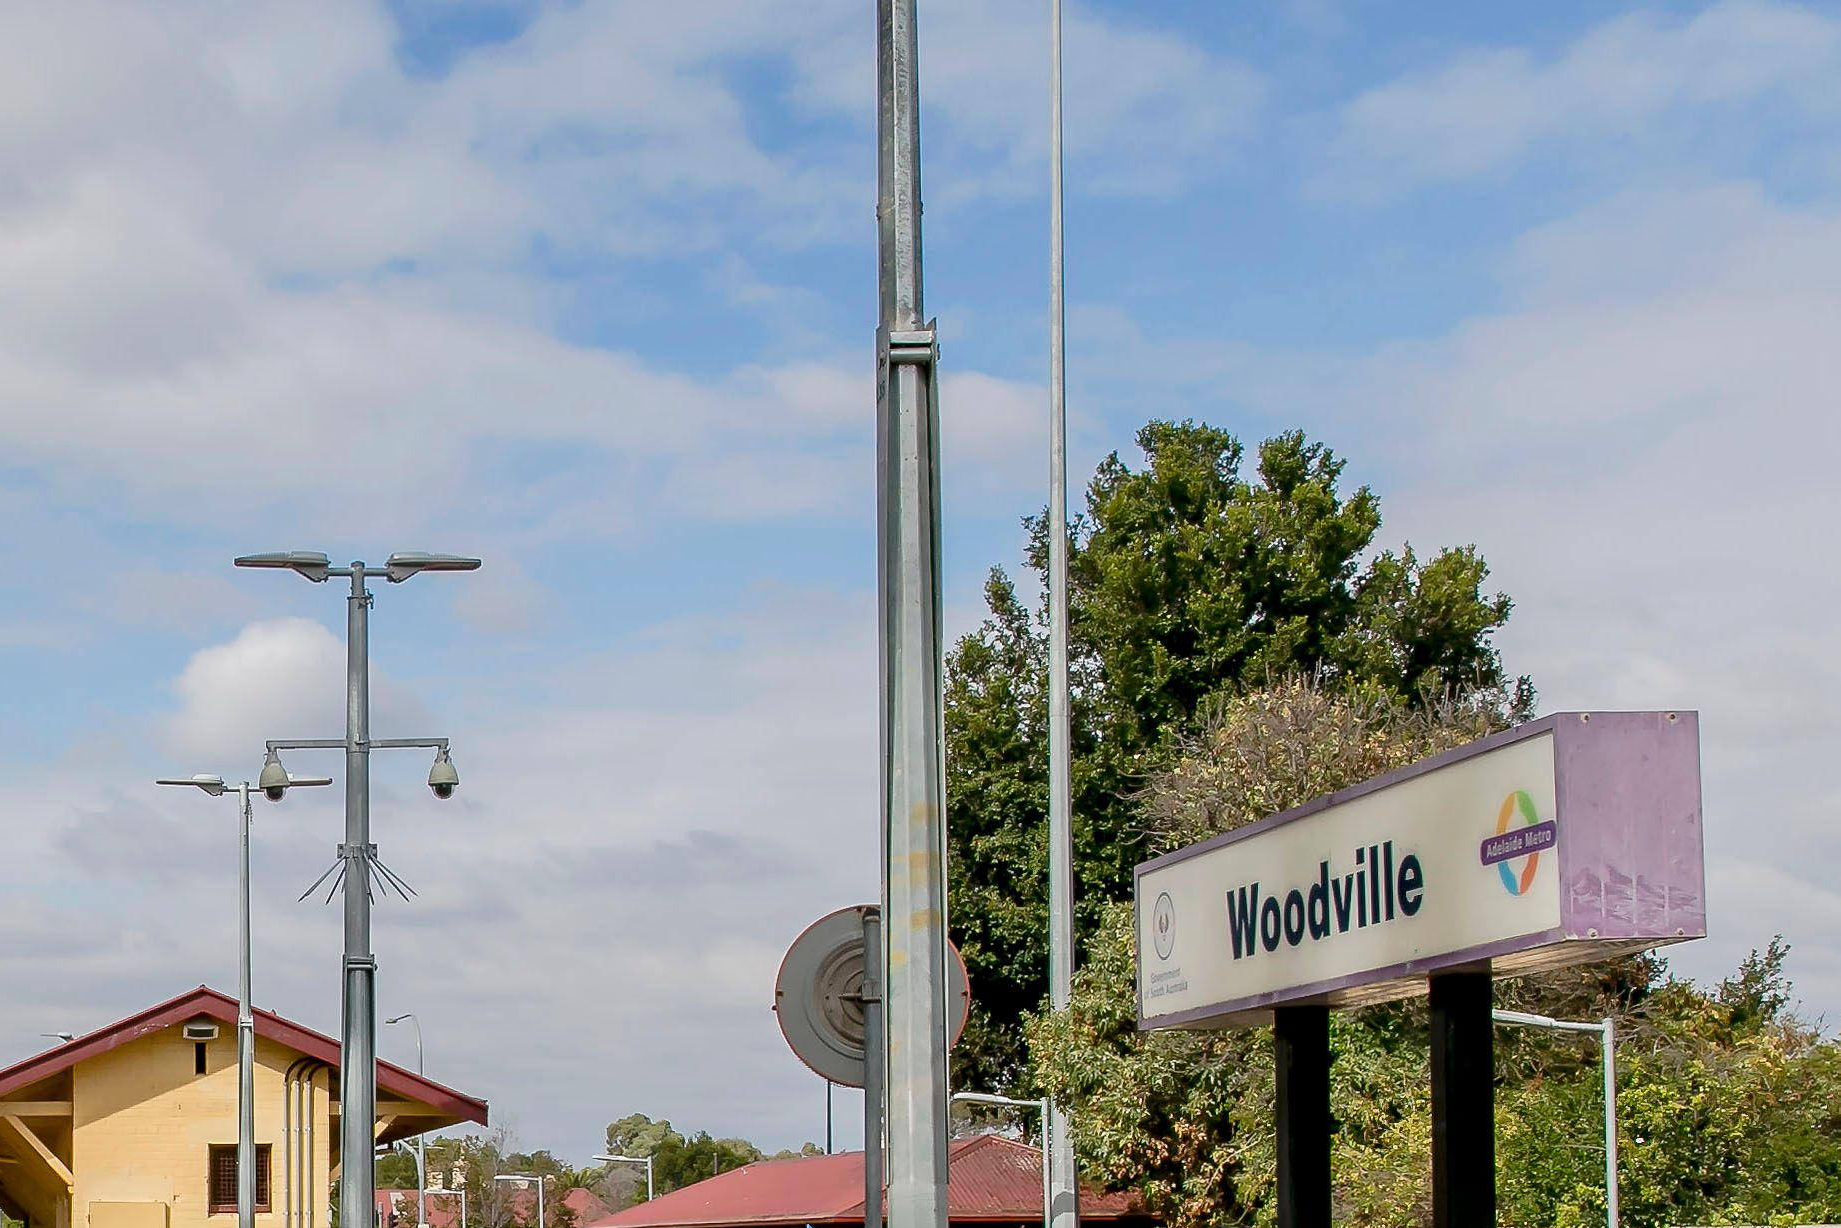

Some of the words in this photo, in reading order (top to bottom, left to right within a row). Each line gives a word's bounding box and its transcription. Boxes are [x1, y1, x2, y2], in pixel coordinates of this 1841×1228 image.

[1486, 835, 1523, 858] Adelaide
[1525, 830, 1552, 848] Metro
[1226, 840, 1424, 960] Woodville
